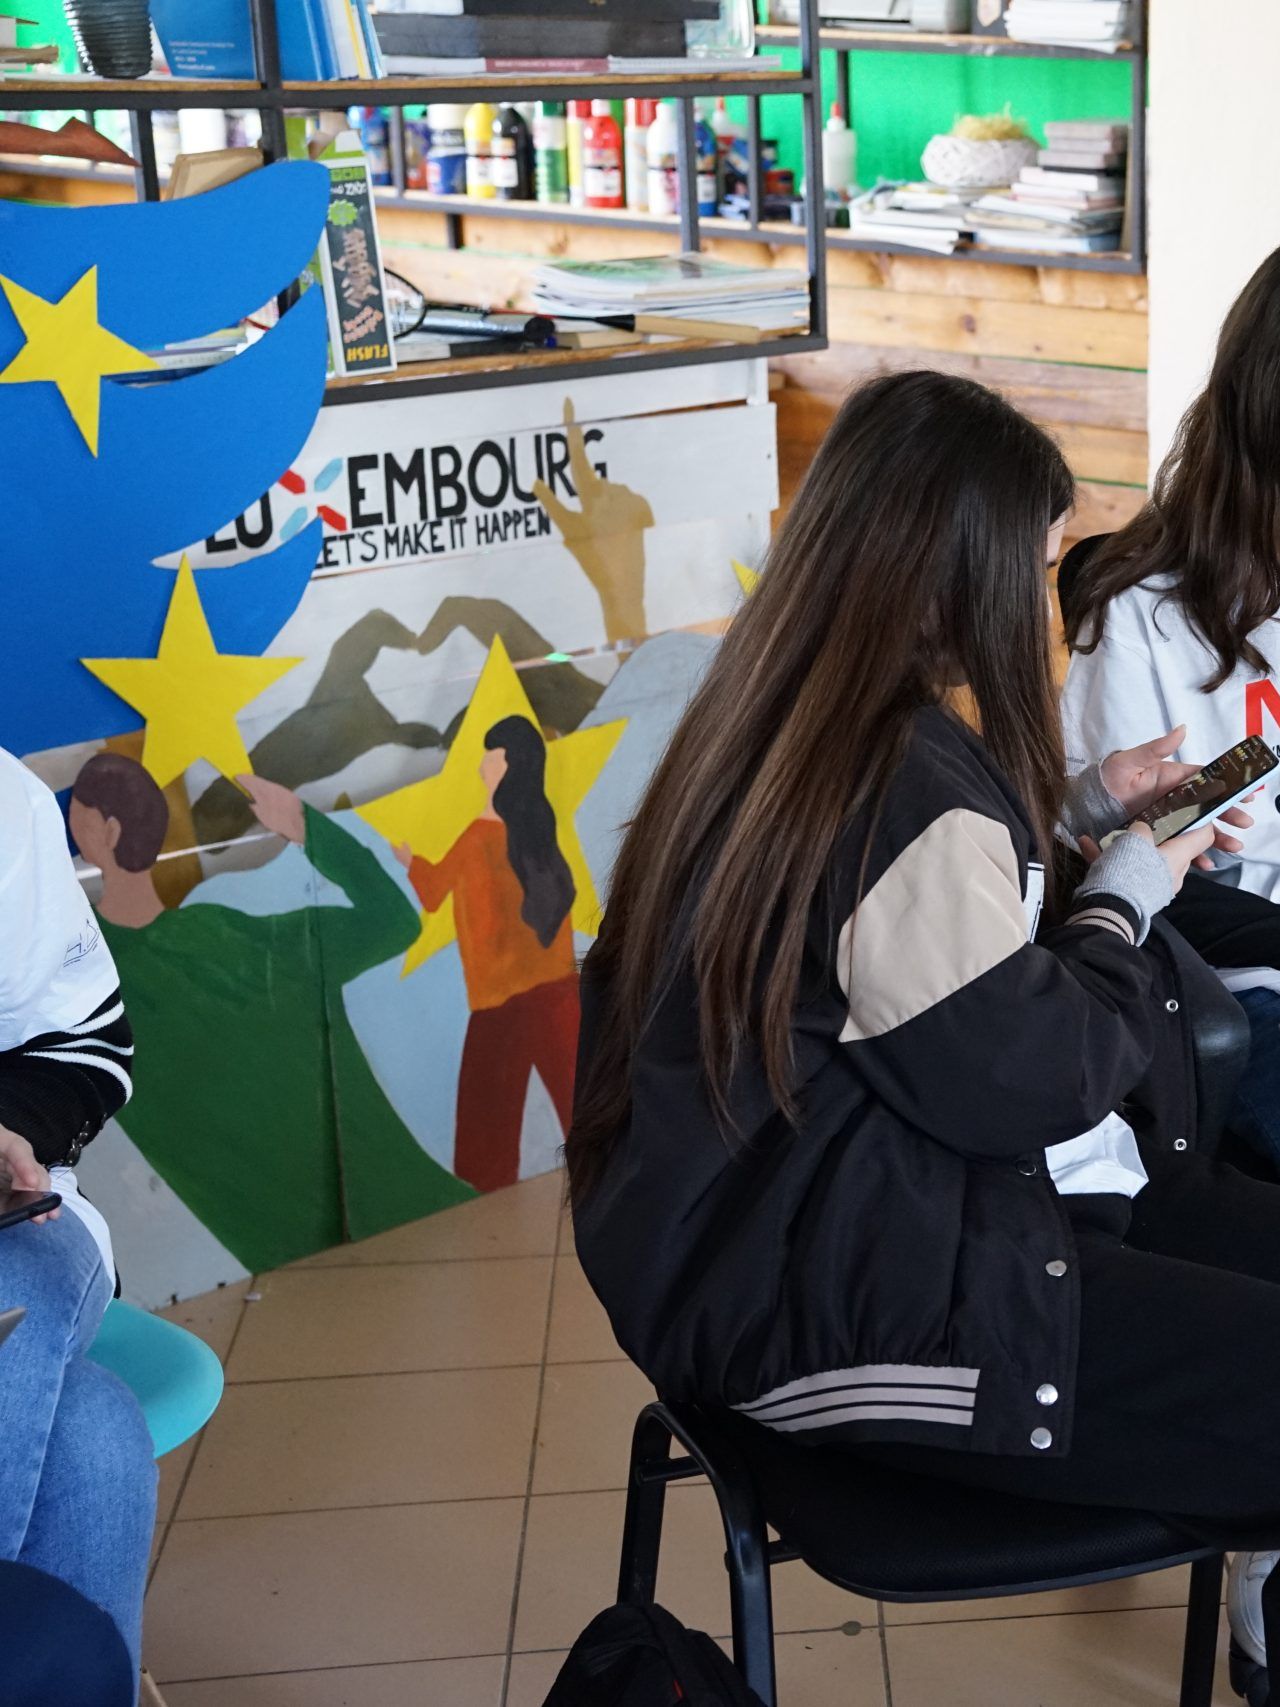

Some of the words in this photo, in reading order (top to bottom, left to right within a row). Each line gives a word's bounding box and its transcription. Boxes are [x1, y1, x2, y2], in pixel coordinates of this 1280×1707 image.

[346, 343, 388, 363] FLASH
[314, 530, 378, 569] ET'S
[384, 519, 446, 560] MAKE
[449, 516, 467, 550] IT
[475, 506, 552, 546] HAPPEN
